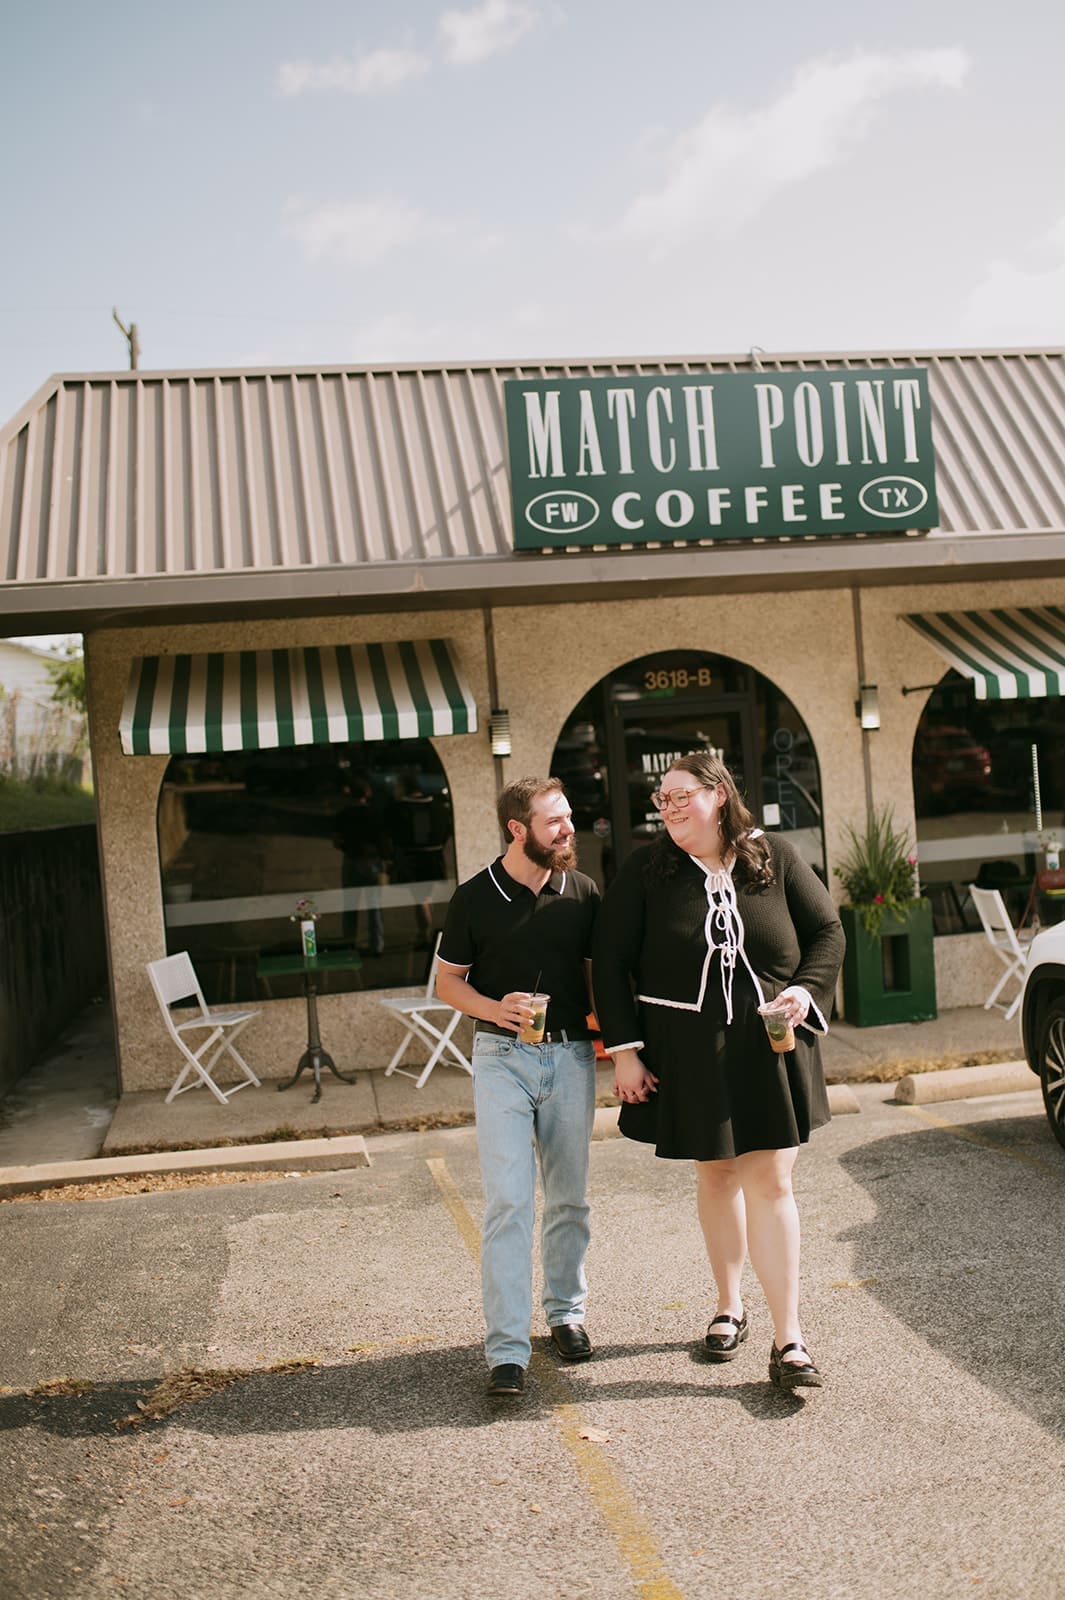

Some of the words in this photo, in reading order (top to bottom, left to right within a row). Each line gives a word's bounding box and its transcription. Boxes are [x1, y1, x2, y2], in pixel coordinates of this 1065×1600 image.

[523, 385, 720, 478] MATCH
[754, 379, 921, 468] POINT
[545, 502, 579, 524] FW
[611, 483, 846, 530] COFFEE
[877, 487, 909, 509] TX
[644, 668, 712, 690] 3618-B
[773, 728, 797, 832] OPEN
